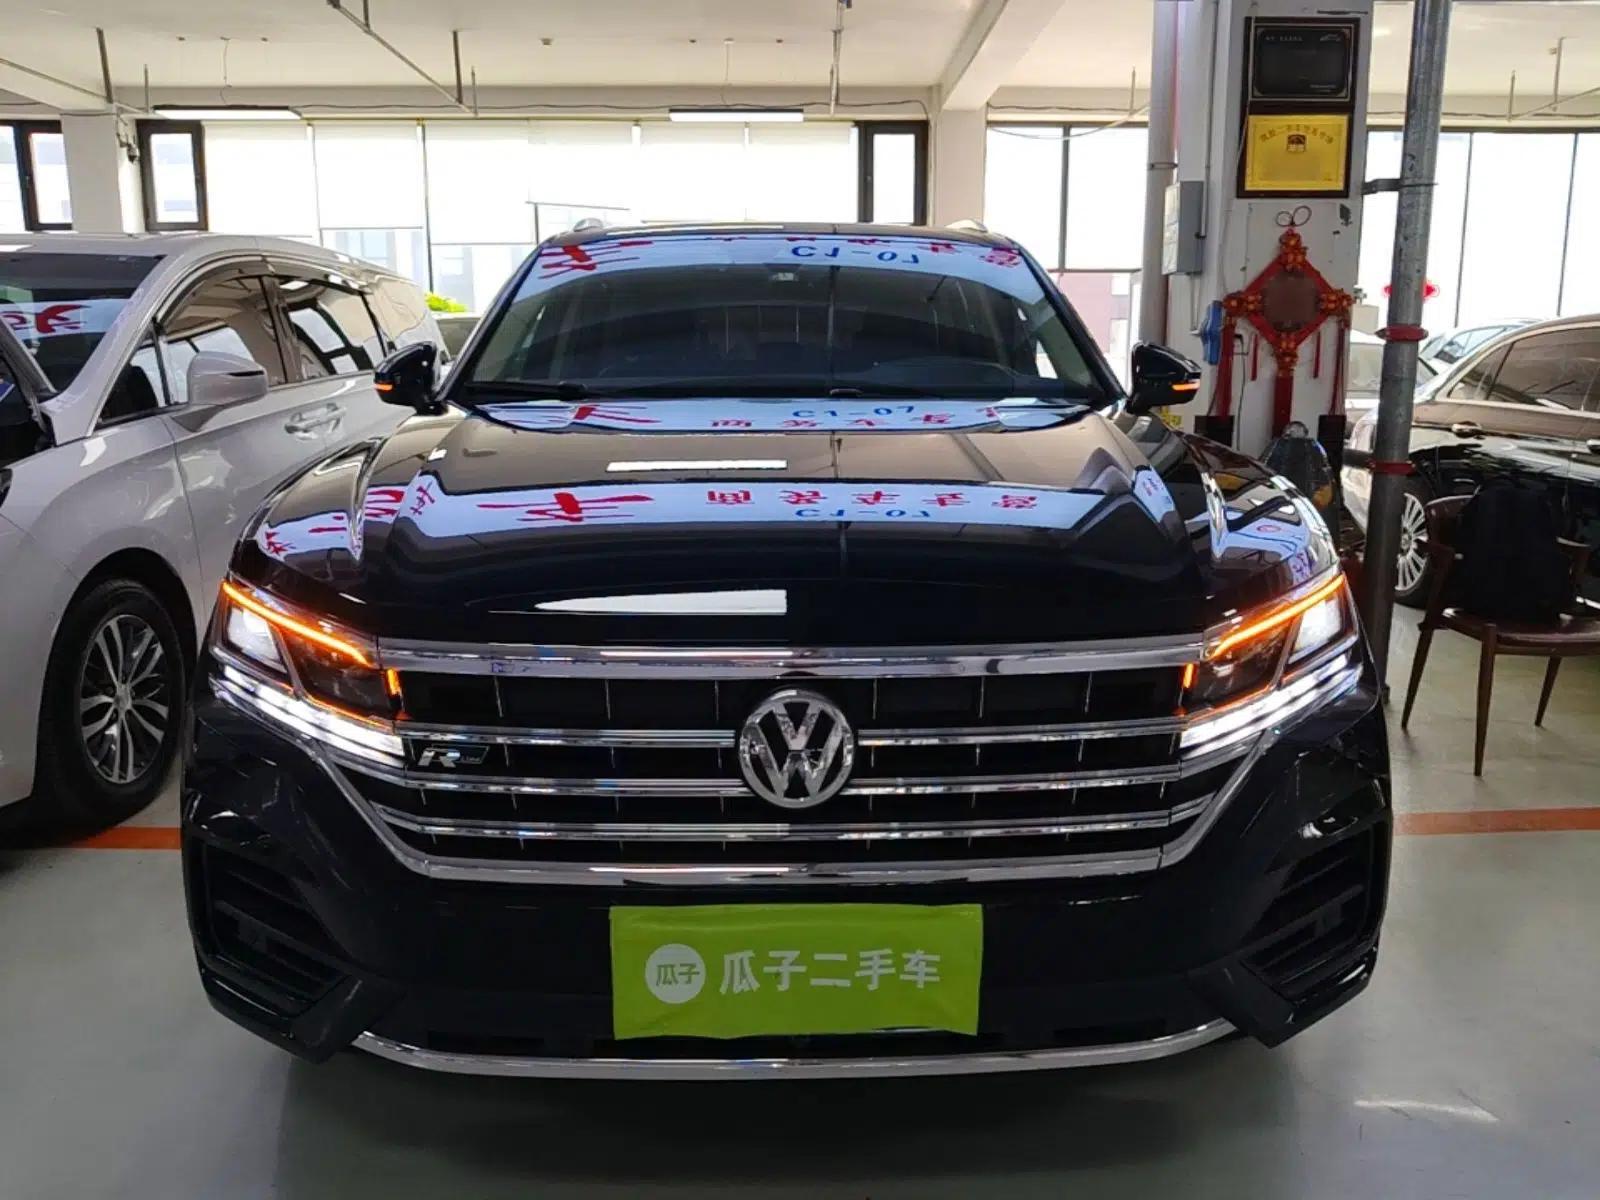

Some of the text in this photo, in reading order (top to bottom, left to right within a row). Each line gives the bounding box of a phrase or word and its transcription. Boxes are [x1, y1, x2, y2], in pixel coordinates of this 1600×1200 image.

[655, 962, 701, 986] 瓜子
[719, 948, 942, 995] 瓜子二手车
